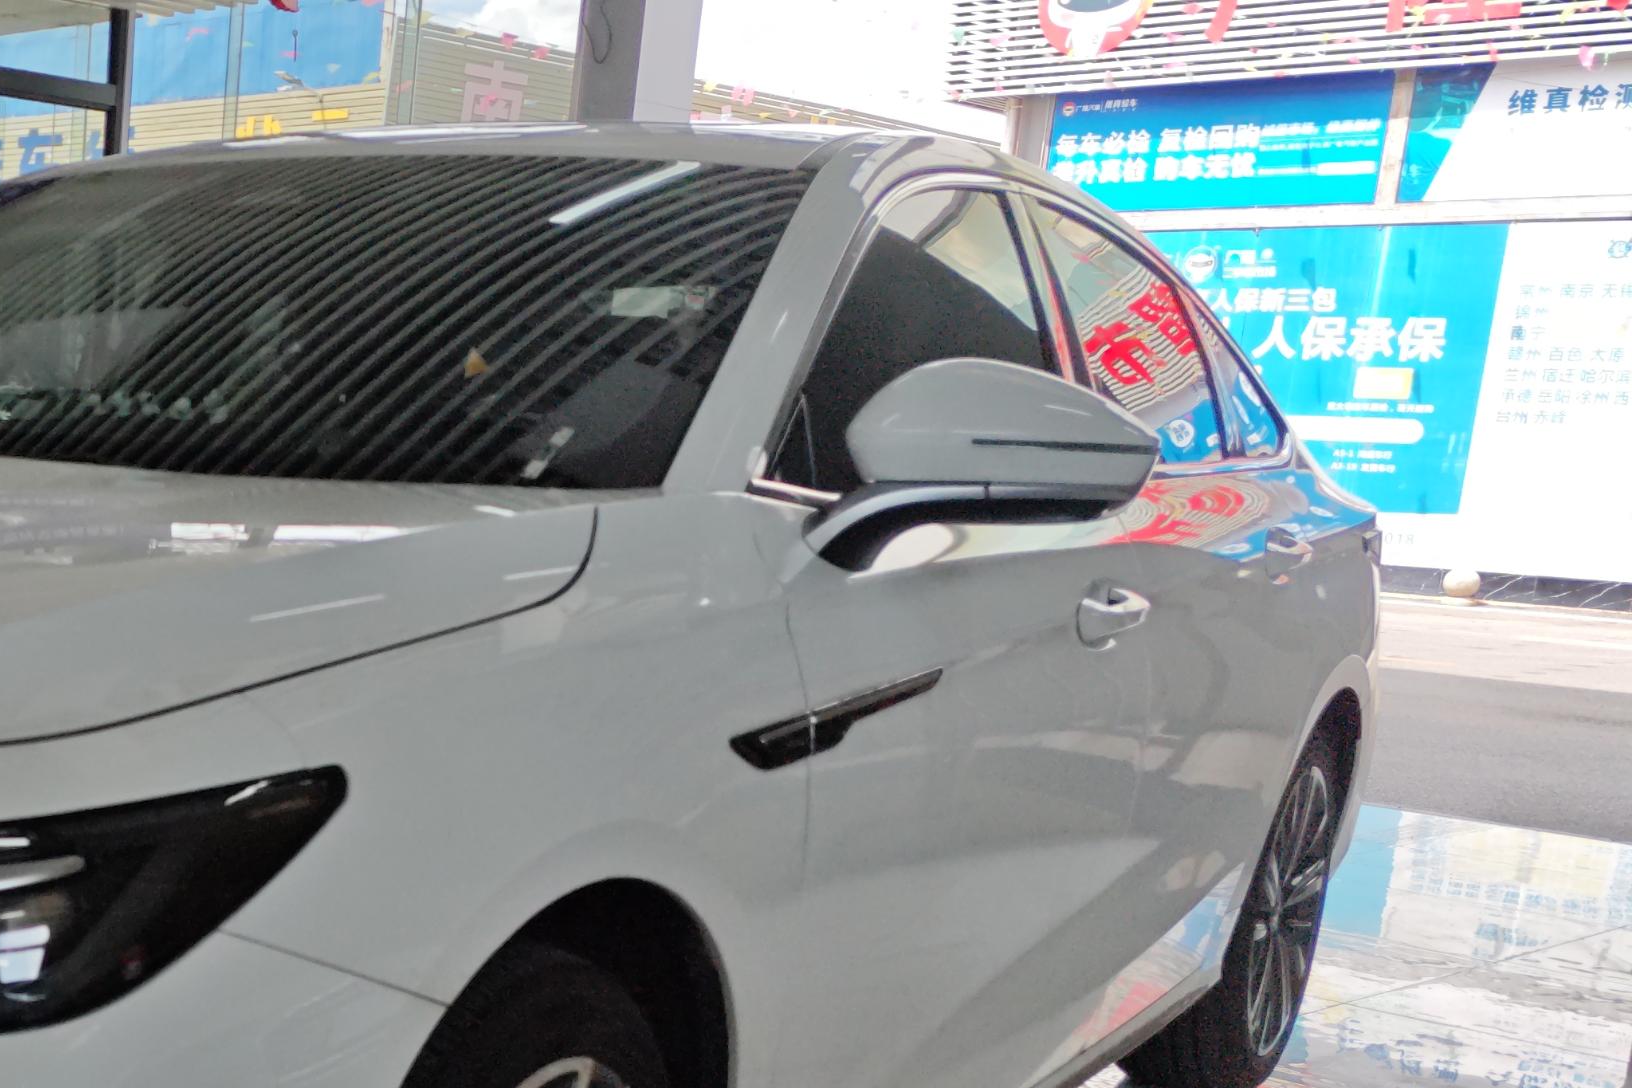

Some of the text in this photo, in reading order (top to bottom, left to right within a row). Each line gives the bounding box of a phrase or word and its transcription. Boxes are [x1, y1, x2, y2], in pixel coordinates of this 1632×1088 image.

[1560, 283, 1594, 298] 南京
[1549, 347, 1582, 362] 百色
[1590, 347, 1624, 362] 太原
